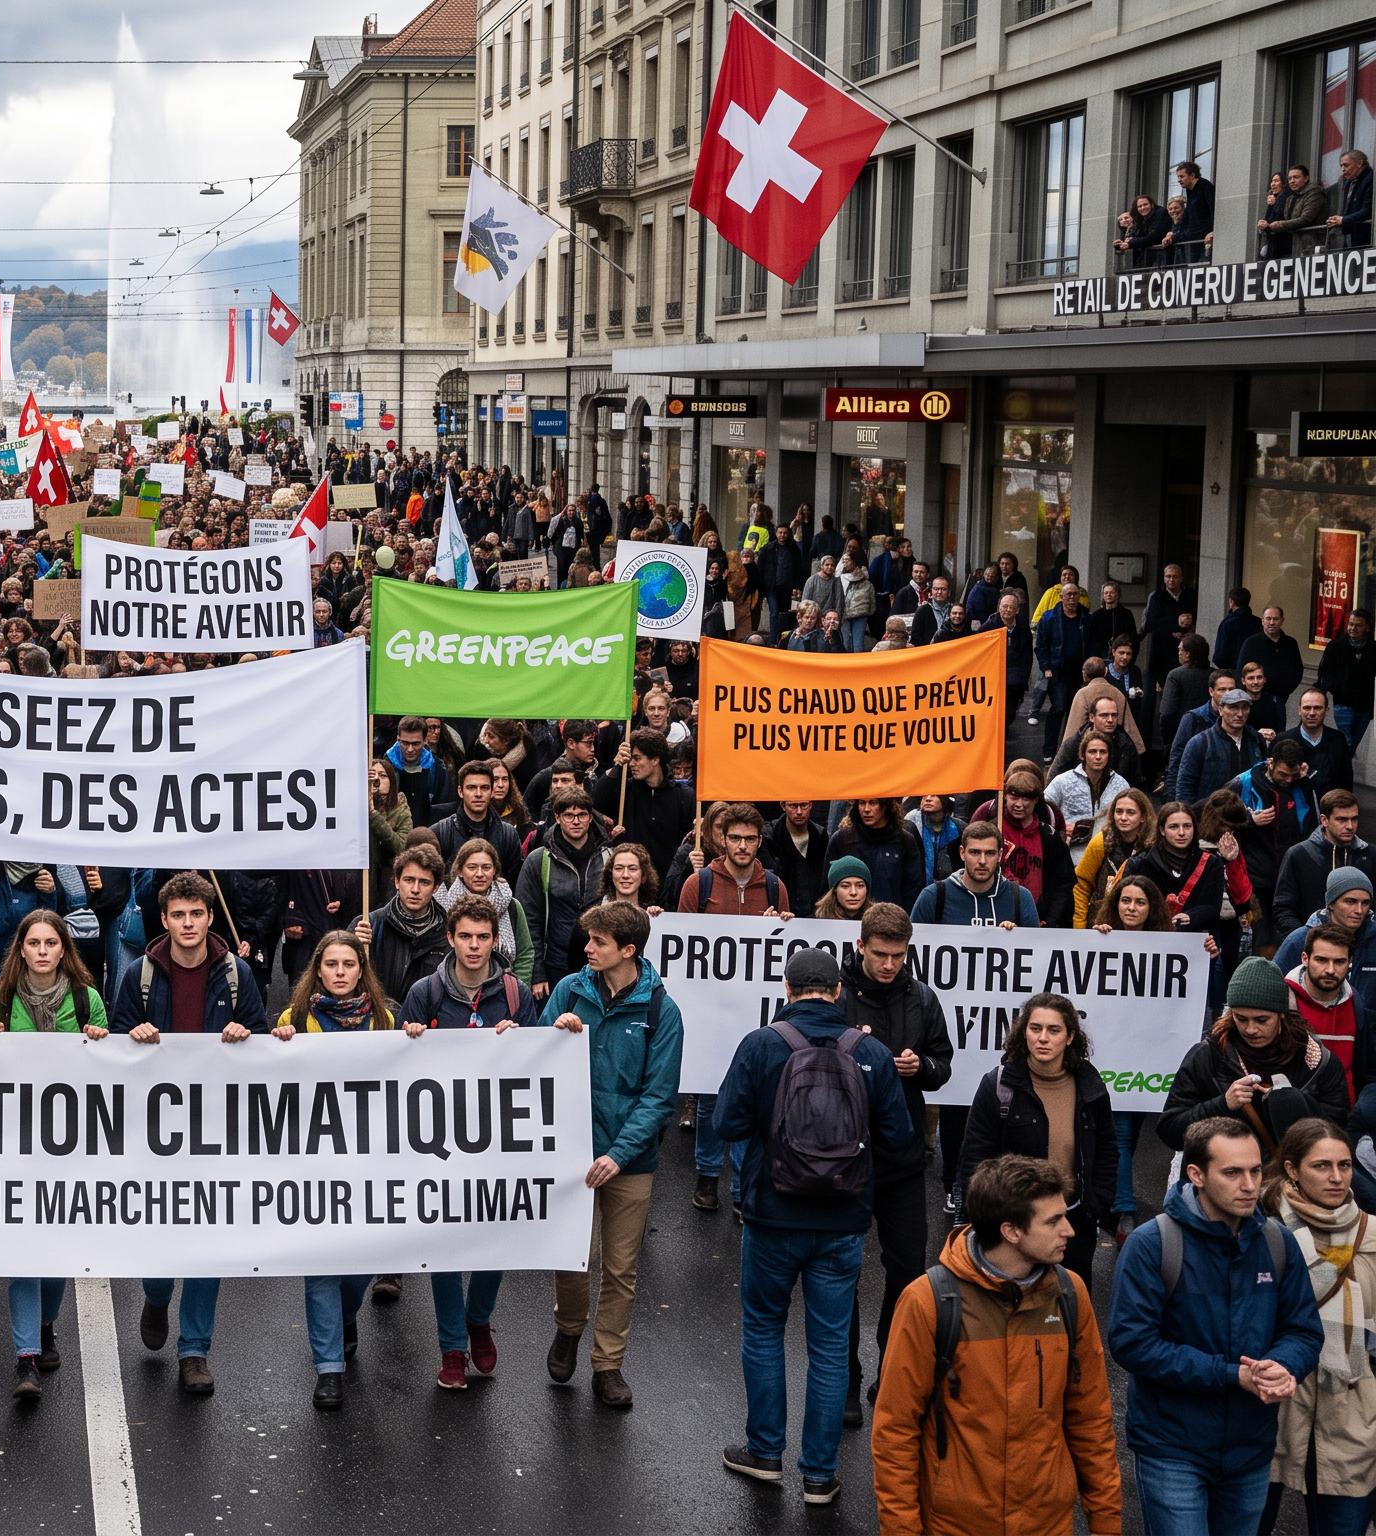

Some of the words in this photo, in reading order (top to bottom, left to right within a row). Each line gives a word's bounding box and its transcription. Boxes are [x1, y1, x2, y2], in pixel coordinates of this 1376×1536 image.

[1054, 278, 1111, 316] RETAIL
[1117, 274, 1143, 310] DE
[1243, 262, 1258, 302] E
[106, 554, 283, 595] PROTÉGONS
[91, 599, 187, 638] NOTRE
[196, 601, 305, 639] AVENIR
[386, 629, 624, 667] GREENPEACE
[715, 685, 771, 713] PLUS
[779, 688, 855, 715] CHAUD
[863, 685, 906, 716] QUE
[914, 674, 994, 711] PRÉVU,
[133, 696, 195, 752] DE
[734, 723, 790, 751] PLUS
[797, 725, 846, 751] VITE
[854, 722, 897, 752] QUE
[903, 715, 975, 747] VOULU
[42, 773, 137, 832] DES
[153, 769, 336, 833] ACTES!
[1044, 949, 1188, 999] AVENIR
[147, 1078, 555, 1161] CLIMATIQUE!
[36, 1180, 240, 1226] MARCHENT
[253, 1180, 351, 1226] POUR
[365, 1180, 406, 1224] LE
[417, 1178, 554, 1225] CLIMAT
